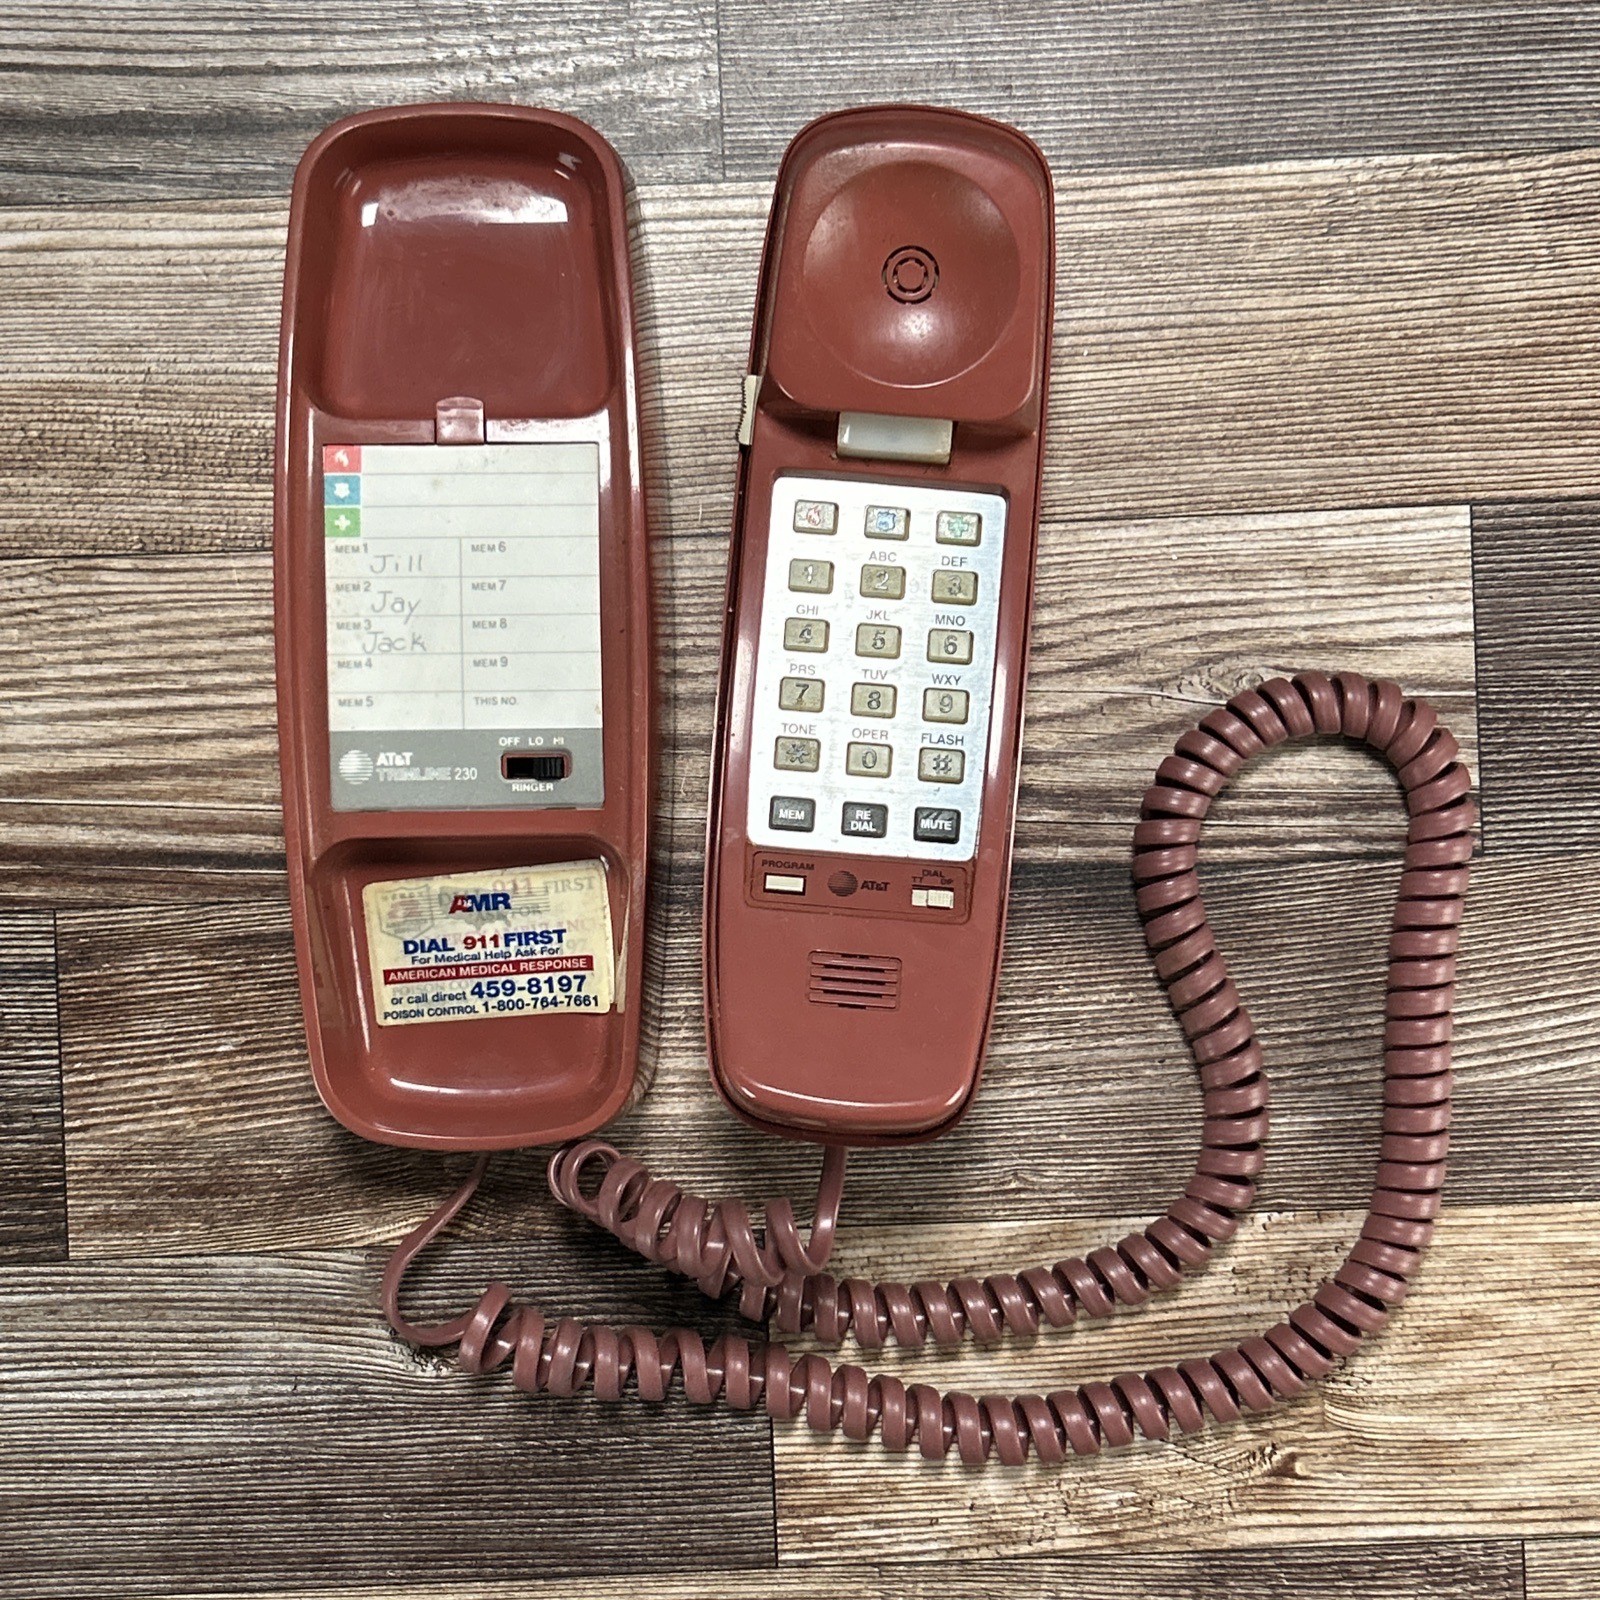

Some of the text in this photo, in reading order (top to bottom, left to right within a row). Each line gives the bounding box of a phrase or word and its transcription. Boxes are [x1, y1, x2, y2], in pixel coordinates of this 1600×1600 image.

[335, 545, 360, 553] MEM
[471, 541, 506, 552] MEM 6
[869, 550, 897, 562] ABC
[941, 556, 967, 567] DEF
[370, 554, 423, 573] Jill
[472, 580, 507, 591] MEM 7
[875, 570, 889, 590] 2
[947, 575, 962, 596] 3
[335, 582, 371, 592] MEM 2
[371, 591, 421, 625] Jay
[796, 604, 819, 616] GHI
[866, 609, 890, 621] JKL
[935, 614, 966, 626] MNO
[336, 619, 372, 630] MEM 3
[472, 618, 507, 629] MEM 8
[362, 632, 427, 654] Jack
[872, 630, 886, 650] 5
[943, 635, 958, 655] 6
[337, 659, 373, 669] MEM 4
[473, 657, 508, 667] MEM 9
[789, 663, 816, 675] PRS
[862, 669, 888, 680] TUV
[932, 674, 962, 685] WXY
[795, 683, 809, 703] 7
[338, 697, 374, 707] MEM 5
[474, 696, 498, 705] THIS
[867, 690, 881, 710] 8
[939, 694, 953, 714] 9
[781, 723, 817, 735] TONE
[852, 728, 889, 740] OPER
[499, 736, 564, 746] OFF LO HI
[921, 733, 964, 746] FLASH
[376, 752, 413, 766] AT&T
[862, 749, 877, 769] 0
[454, 767, 477, 780] 230
[512, 783, 553, 792] RINGER
[778, 809, 805, 820] MEM
[855, 810, 871, 820] RE
[850, 821, 876, 832] DIAL
[920, 819, 952, 831] MUTE
[762, 859, 814, 871] PROGRAM
[922, 869, 945, 878] DIAL
[861, 880, 890, 892] AT&T
[449, 892, 512, 914] AMR
[403, 937, 455, 954] DIAL
[462, 934, 499, 950] 911
[504, 929, 567, 947] FIRST
[411, 946, 560, 965] For Medical Help Ask For
[388, 957, 587, 981] AMERICAN MEDICAL RESPONSE
[391, 997, 404, 1005] or
[407, 994, 428, 1004] call
[431, 991, 467, 1002] direct
[470, 974, 587, 999] 459-8197
[384, 994, 599, 1020] POISON CONTROL 1-800-764-7661
